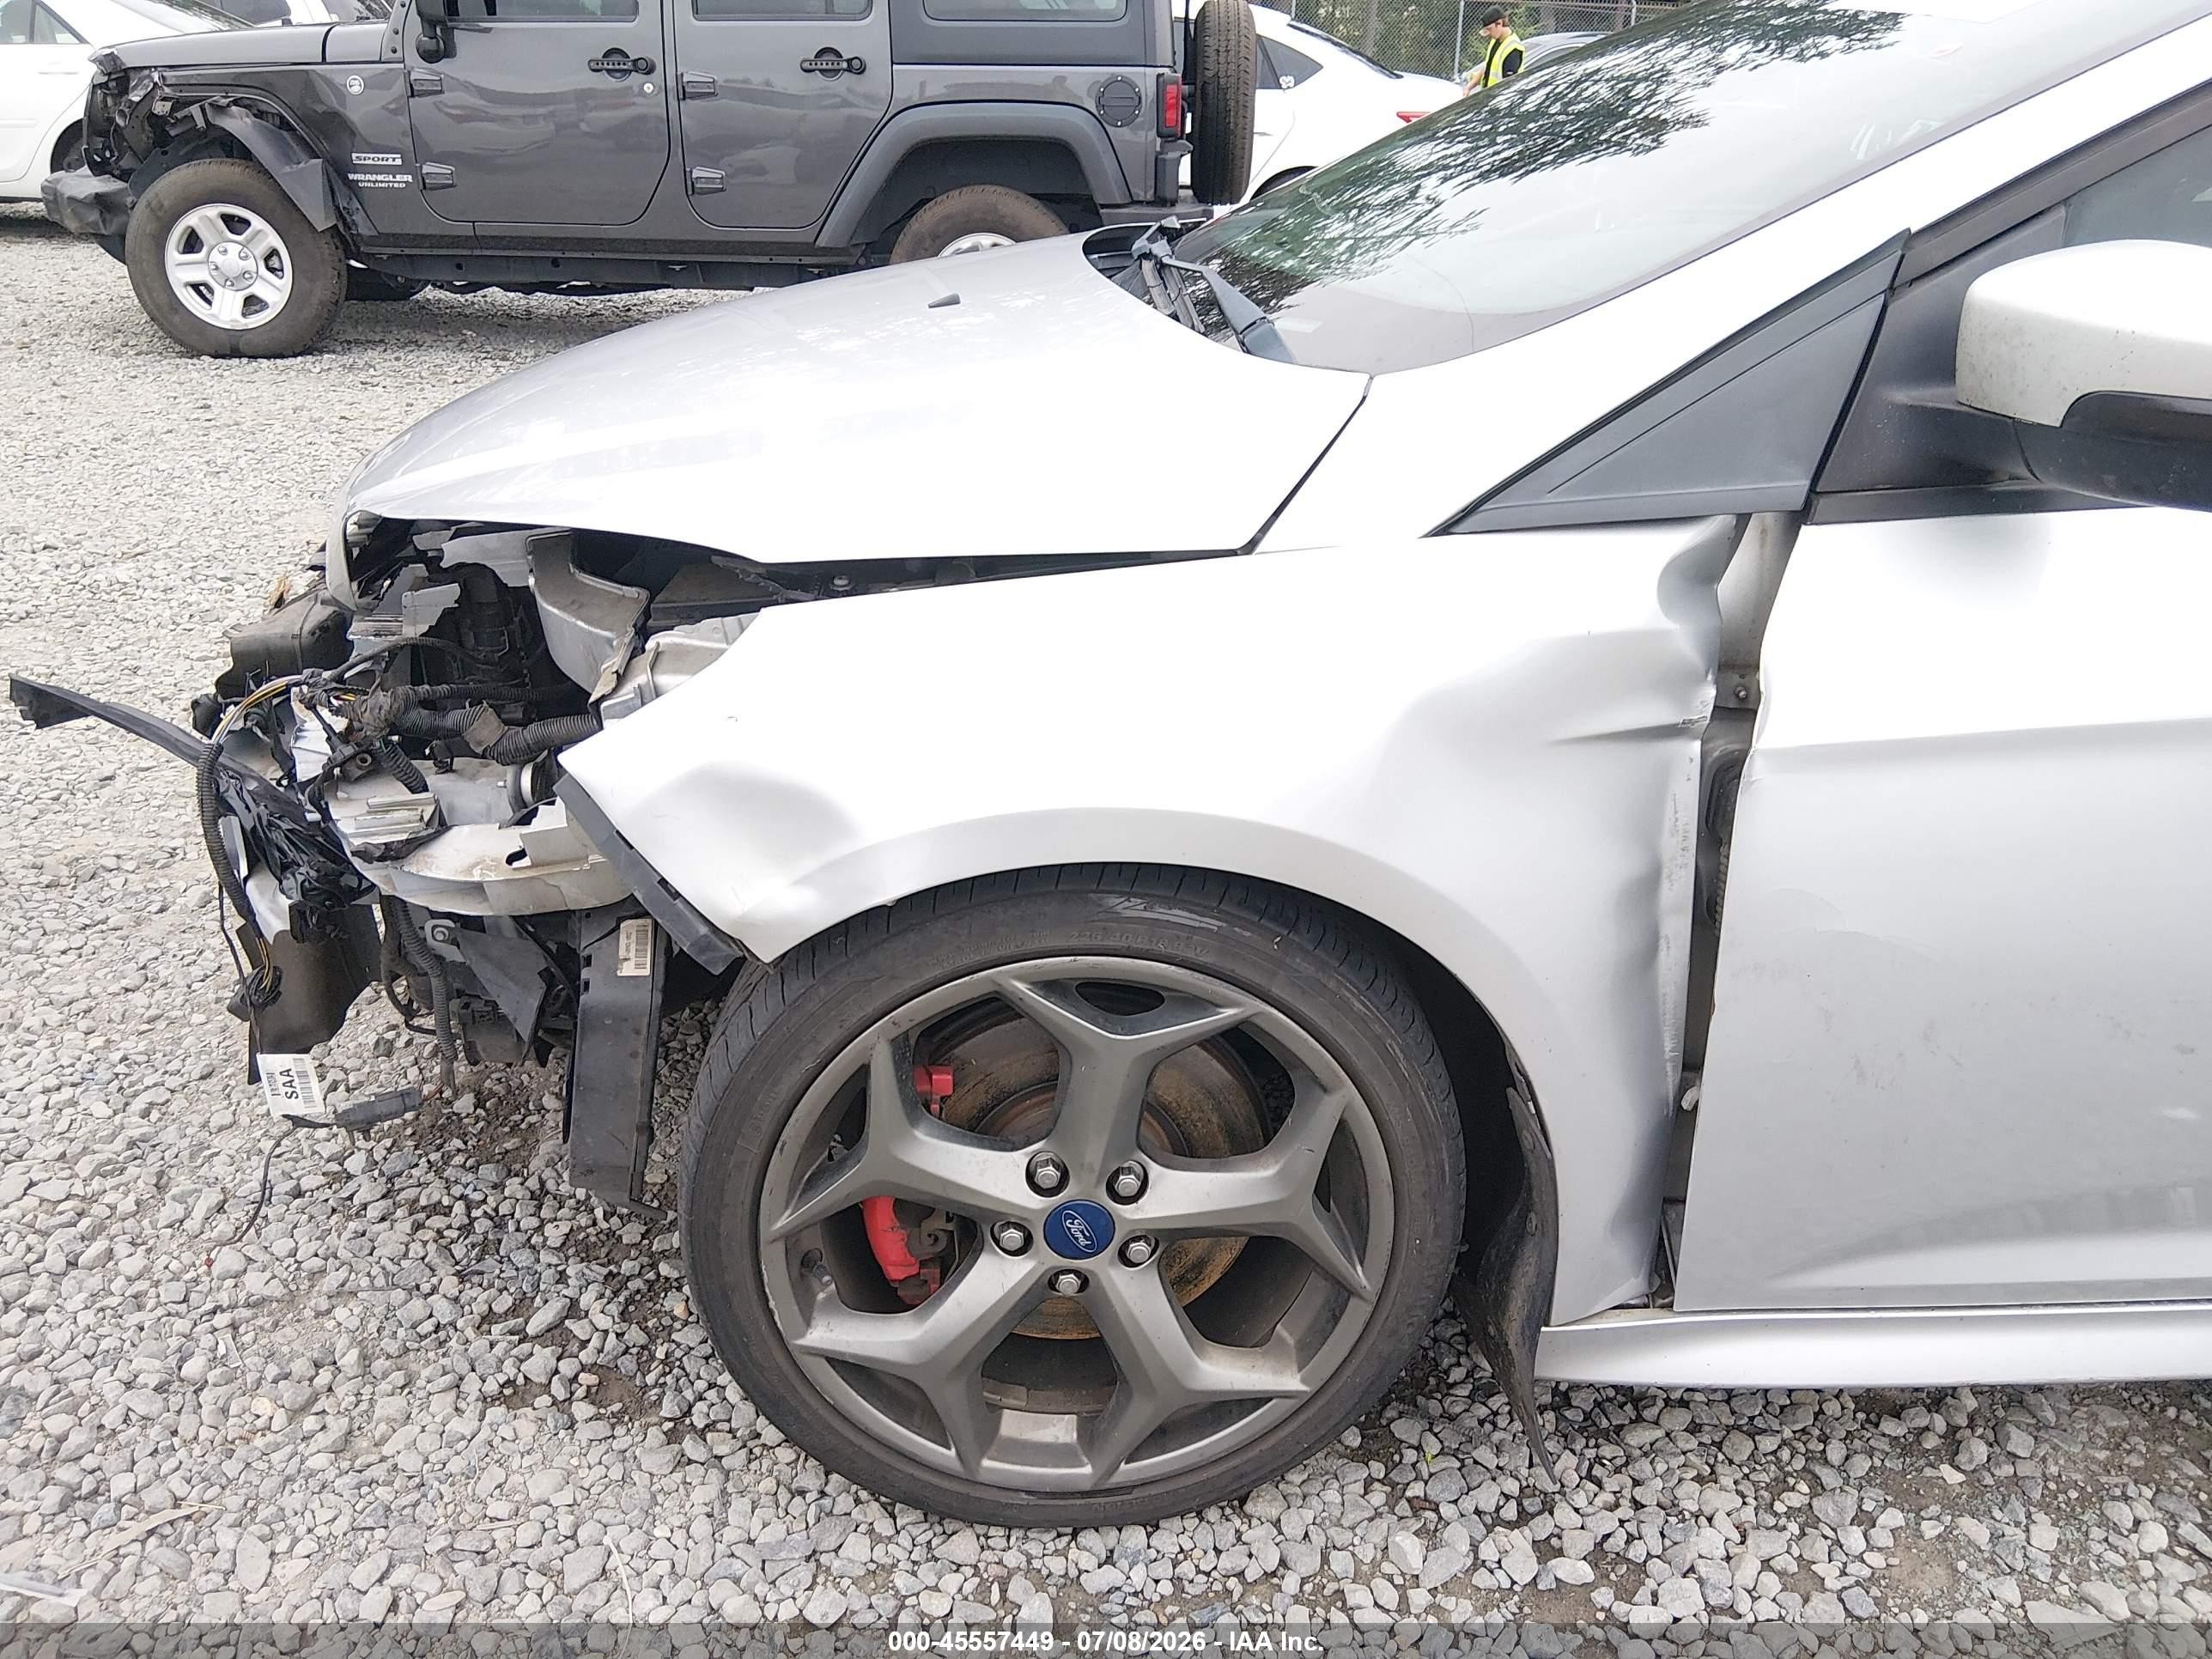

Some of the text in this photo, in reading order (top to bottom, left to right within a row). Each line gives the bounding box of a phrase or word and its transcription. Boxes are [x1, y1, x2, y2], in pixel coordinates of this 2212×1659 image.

[347, 173, 413, 182] WRANGLER
[279, 1068, 299, 1099] SAA
[1066, 1219, 1091, 1246] Ford
